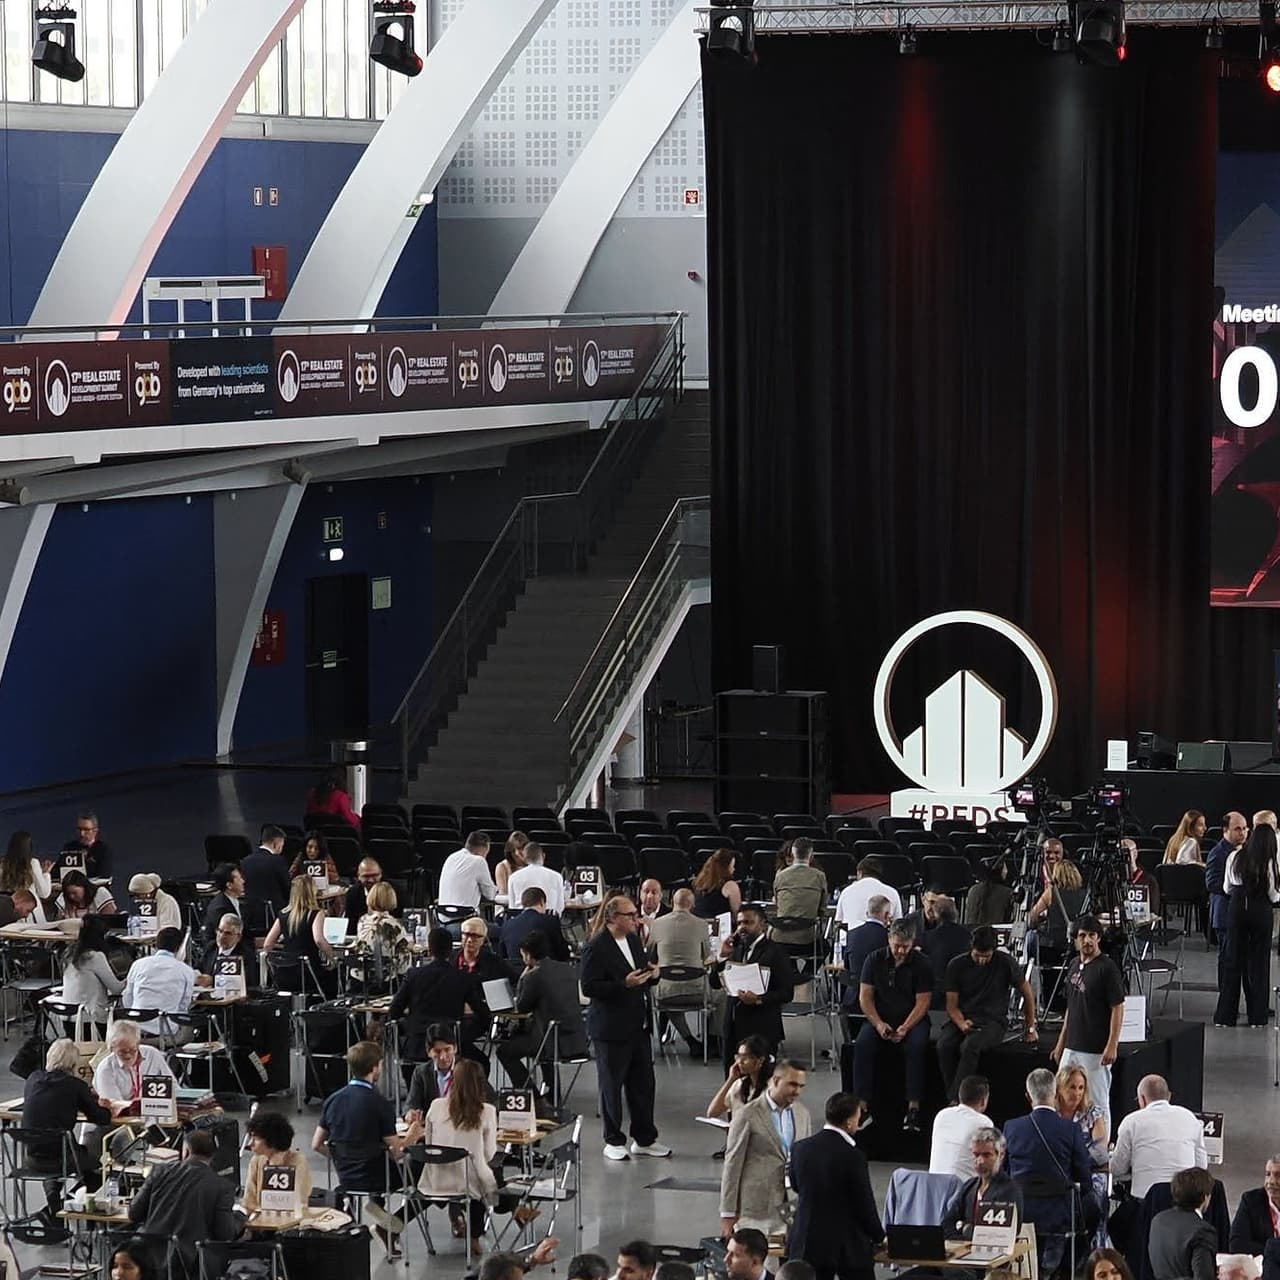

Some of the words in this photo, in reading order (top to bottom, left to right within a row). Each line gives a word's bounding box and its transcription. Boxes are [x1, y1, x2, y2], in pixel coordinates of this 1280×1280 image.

[177, 365, 208, 378] Developed
[208, 365, 220, 377] with
[221, 365, 242, 378] leading
[242, 363, 269, 375] scientists
[178, 385, 192, 397] from
[192, 384, 222, 398] Germany's
[222, 384, 233, 398] top
[233, 382, 265, 395] universities
[65, 856, 78, 866] 01
[307, 865, 321, 876] 02
[580, 870, 594, 882] 03
[1127, 890, 1143, 901] 05
[139, 904, 152, 916] 12
[221, 962, 237, 974] 23
[147, 1083, 166, 1097] 32
[506, 1096, 525, 1110] 33
[268, 1174, 289, 1189] 43
[983, 1210, 1006, 1225] 44
